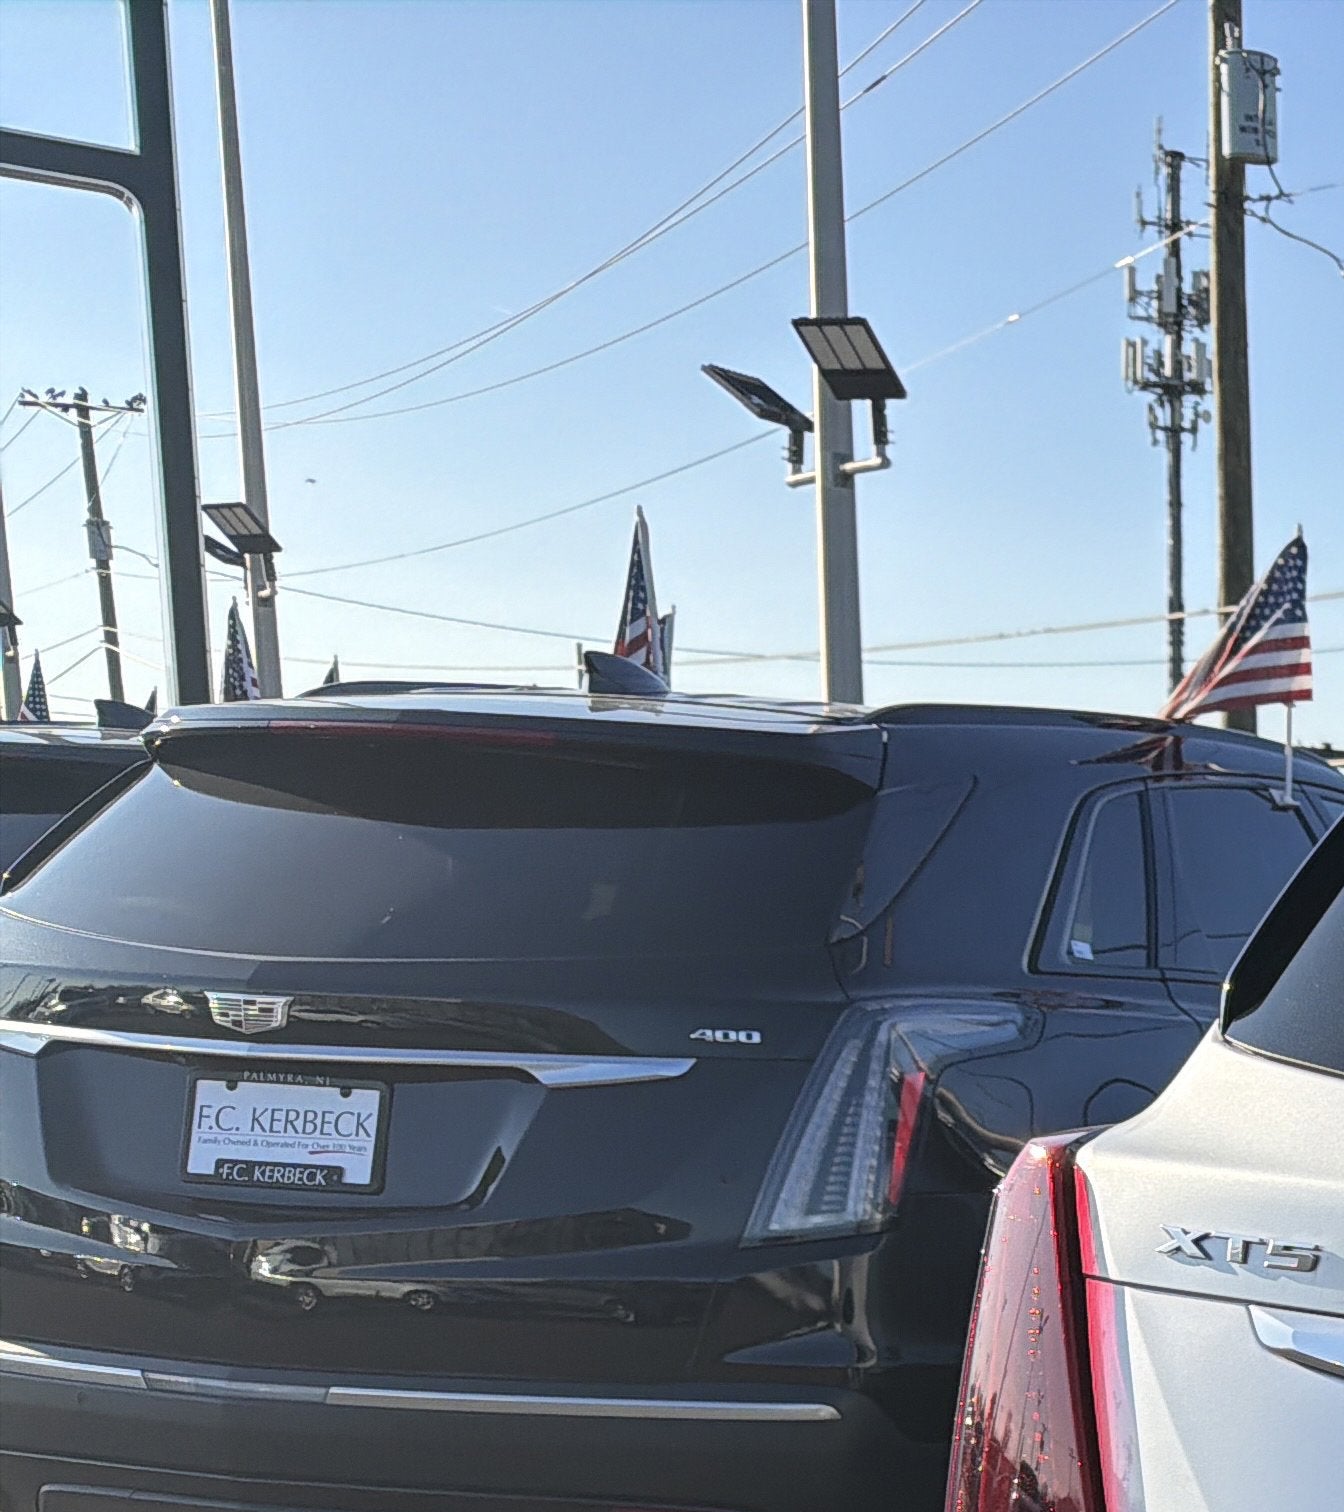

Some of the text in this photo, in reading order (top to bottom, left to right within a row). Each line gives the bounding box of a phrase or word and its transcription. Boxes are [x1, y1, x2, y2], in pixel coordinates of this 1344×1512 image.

[689, 1029, 762, 1044] 400
[197, 1104, 373, 1138] F.C. KERBECK
[222, 1163, 328, 1185] F.C. KERBECK
[1154, 1224, 1321, 1272] XT5
